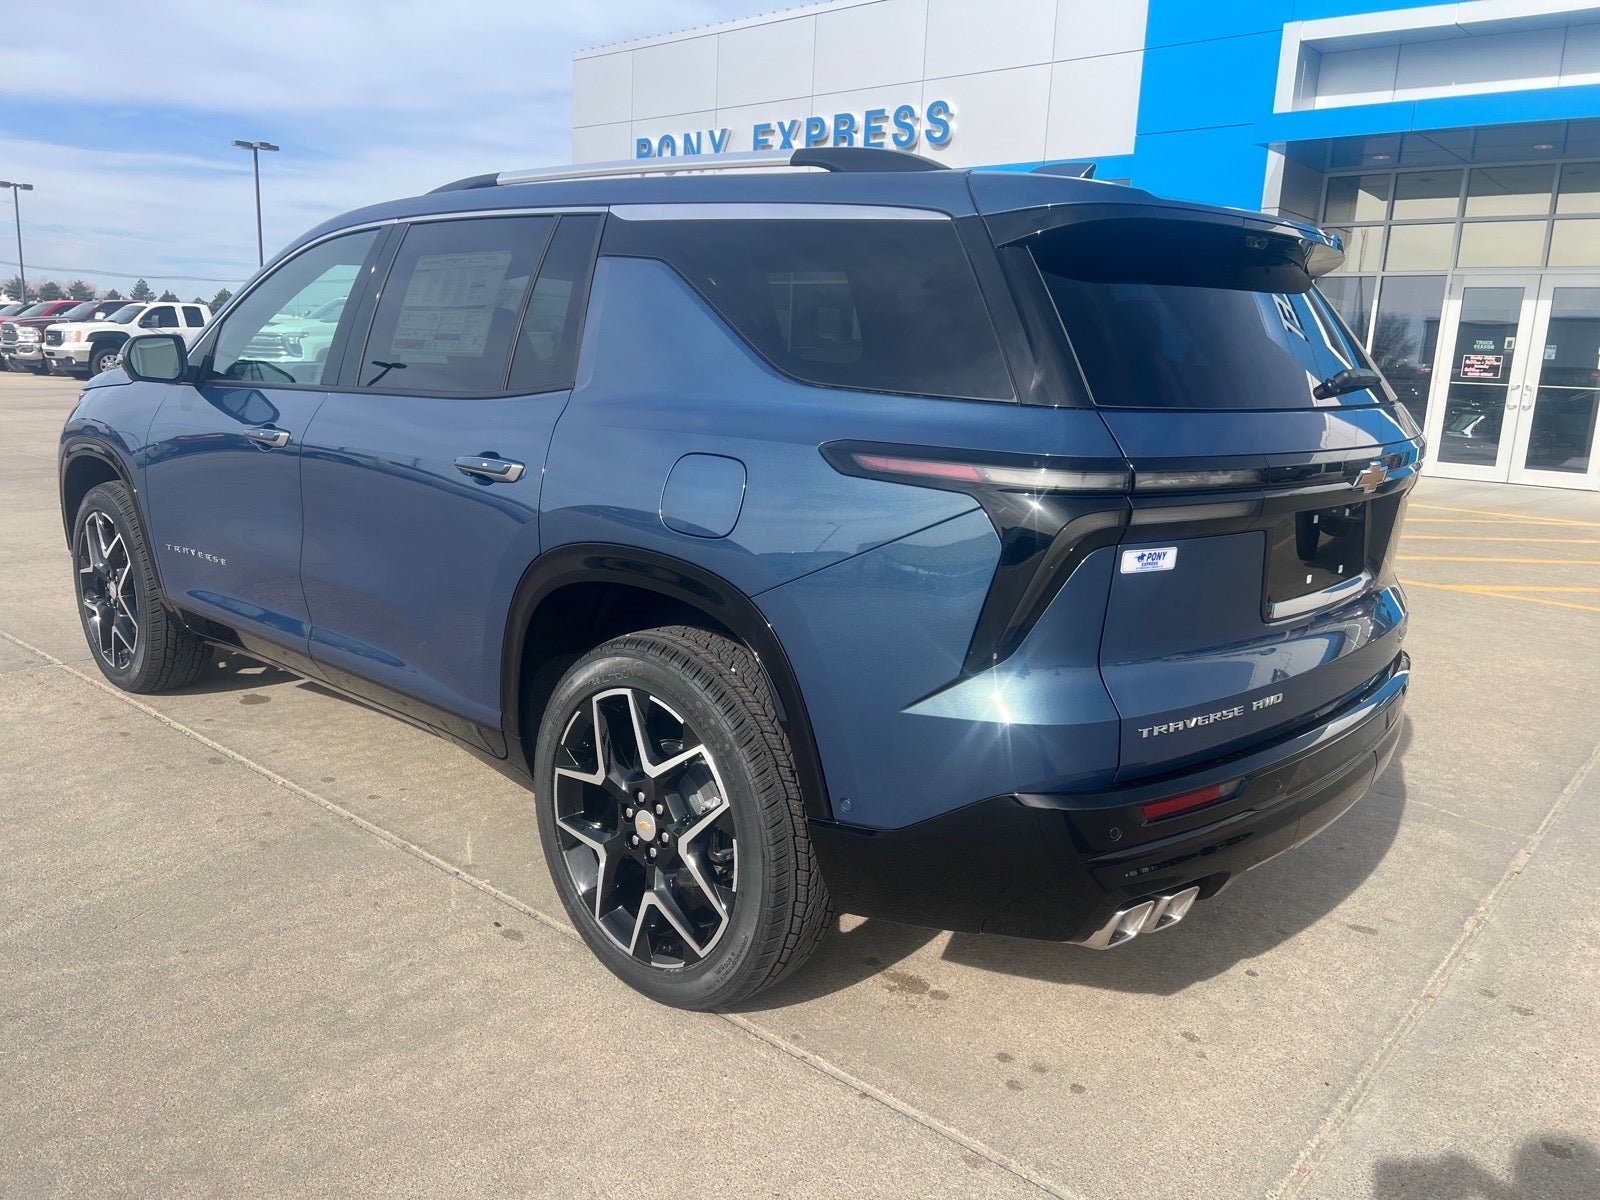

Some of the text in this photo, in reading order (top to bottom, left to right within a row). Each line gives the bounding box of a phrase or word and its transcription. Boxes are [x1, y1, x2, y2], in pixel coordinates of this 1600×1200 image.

[636, 99, 955, 160] PONY EXPRESS
[165, 543, 227, 566] TRAVERSE
[1146, 551, 1168, 562] PONY
[1138, 692, 1283, 738] TRAVERSE AWD
